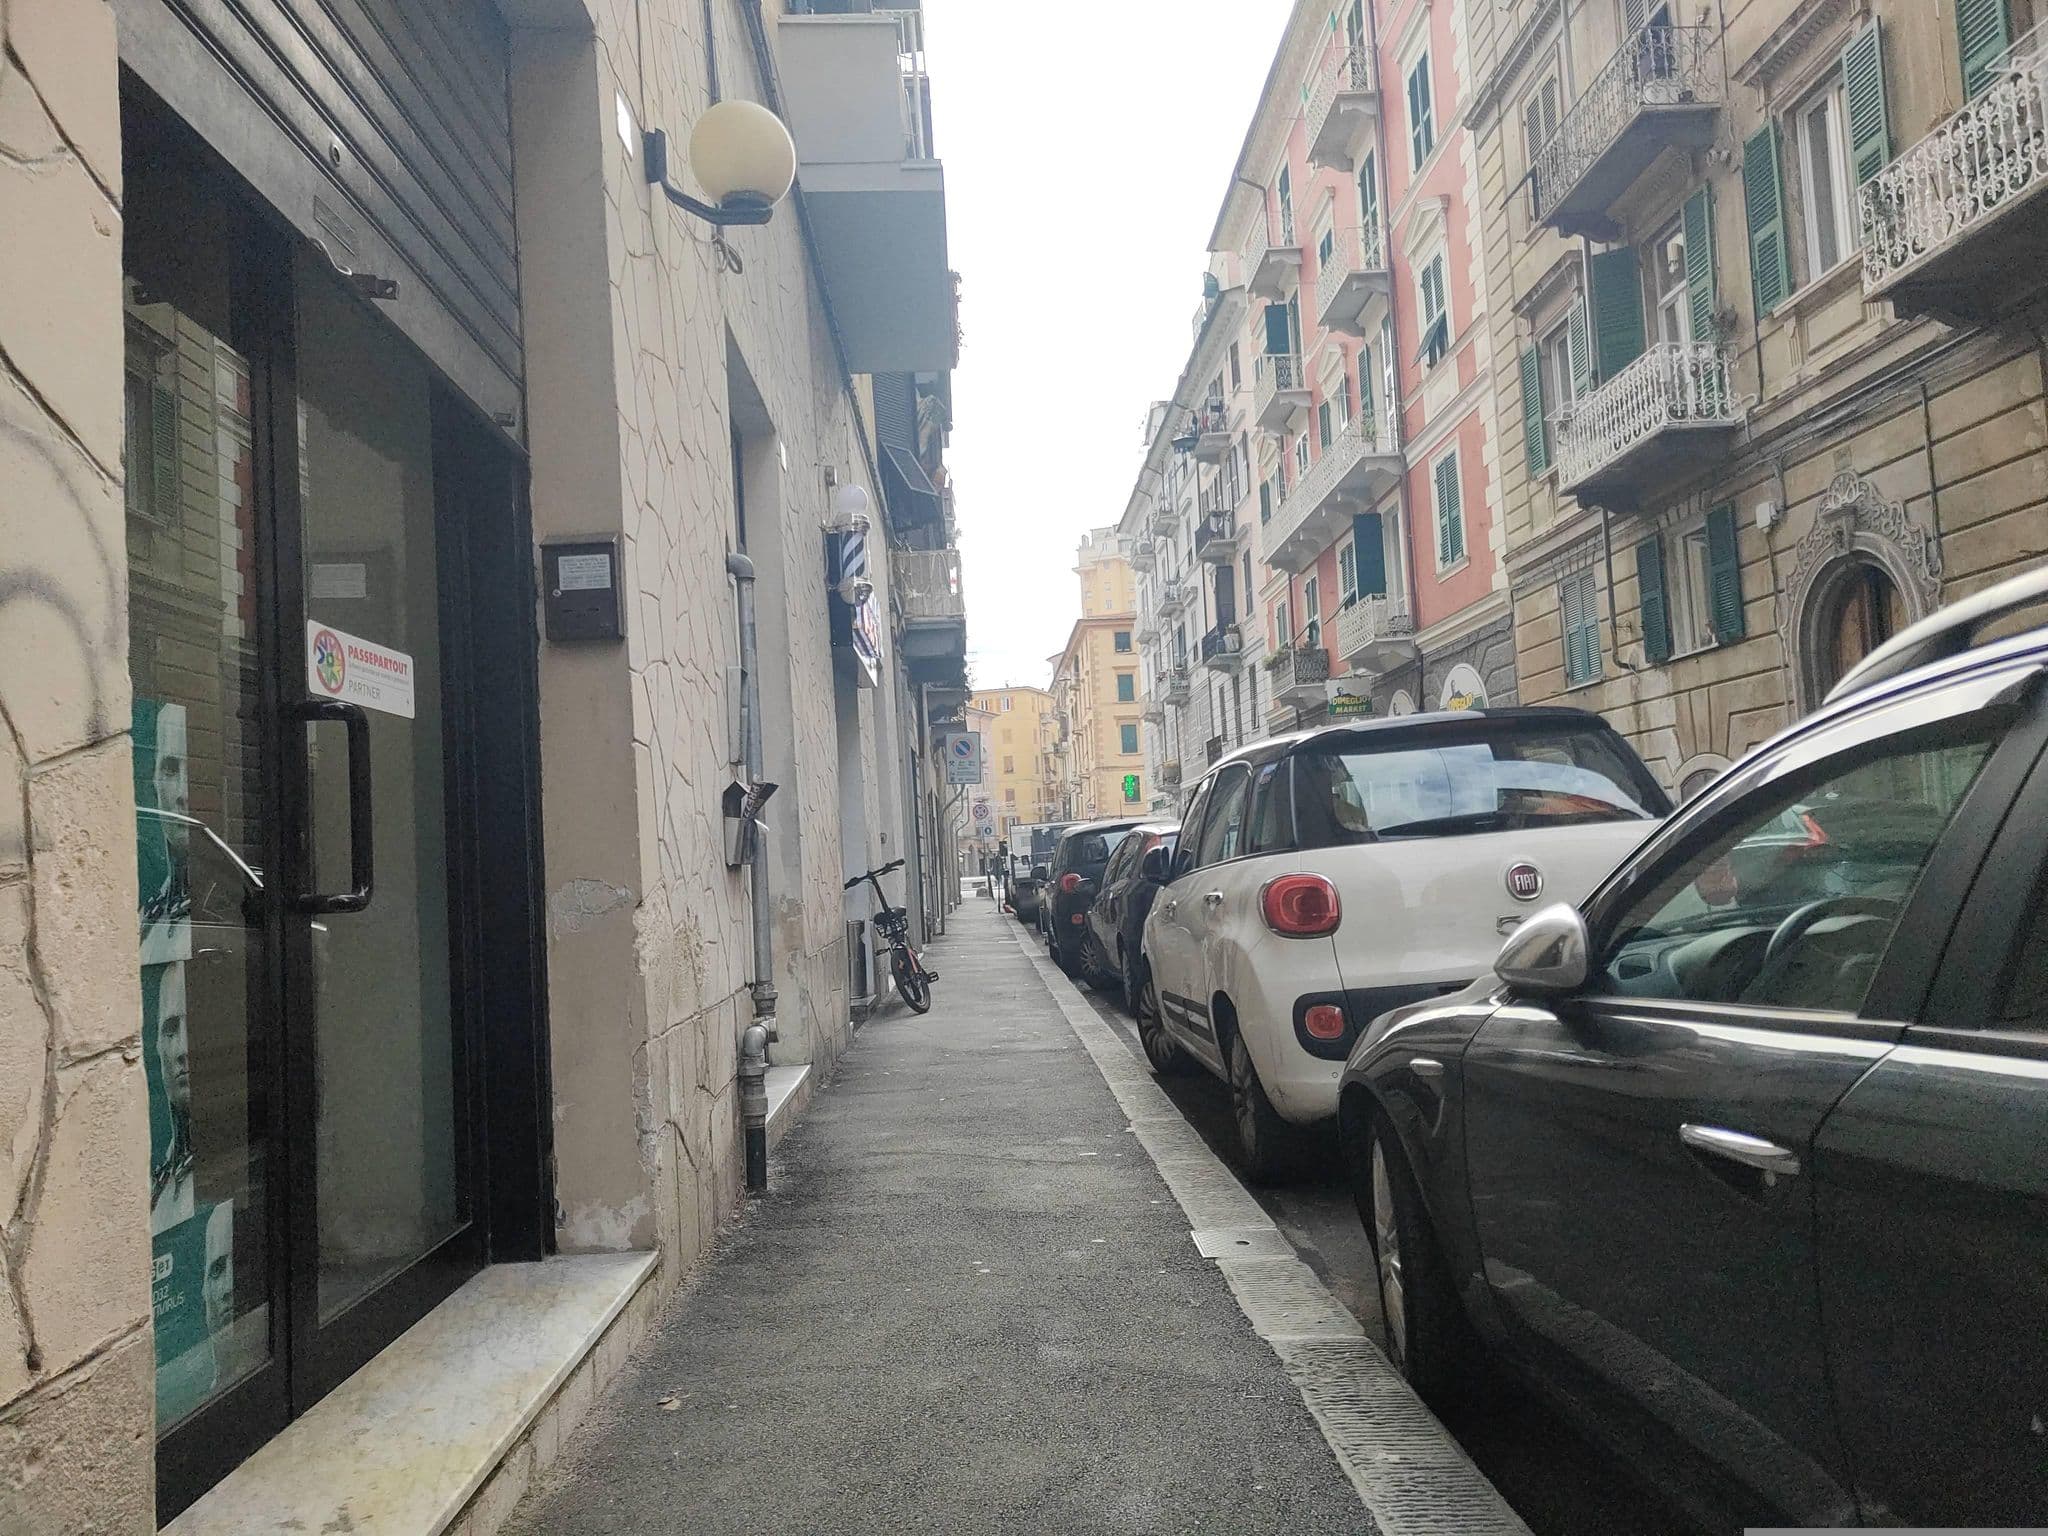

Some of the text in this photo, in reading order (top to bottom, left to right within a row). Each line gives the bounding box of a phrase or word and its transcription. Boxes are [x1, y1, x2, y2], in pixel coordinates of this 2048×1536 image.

[347, 645, 408, 676] PASSEPARTOUT
[348, 679, 381, 699] PARTNER
[1336, 704, 1367, 714] MARKET
[1514, 873, 1536, 891] FIAT
